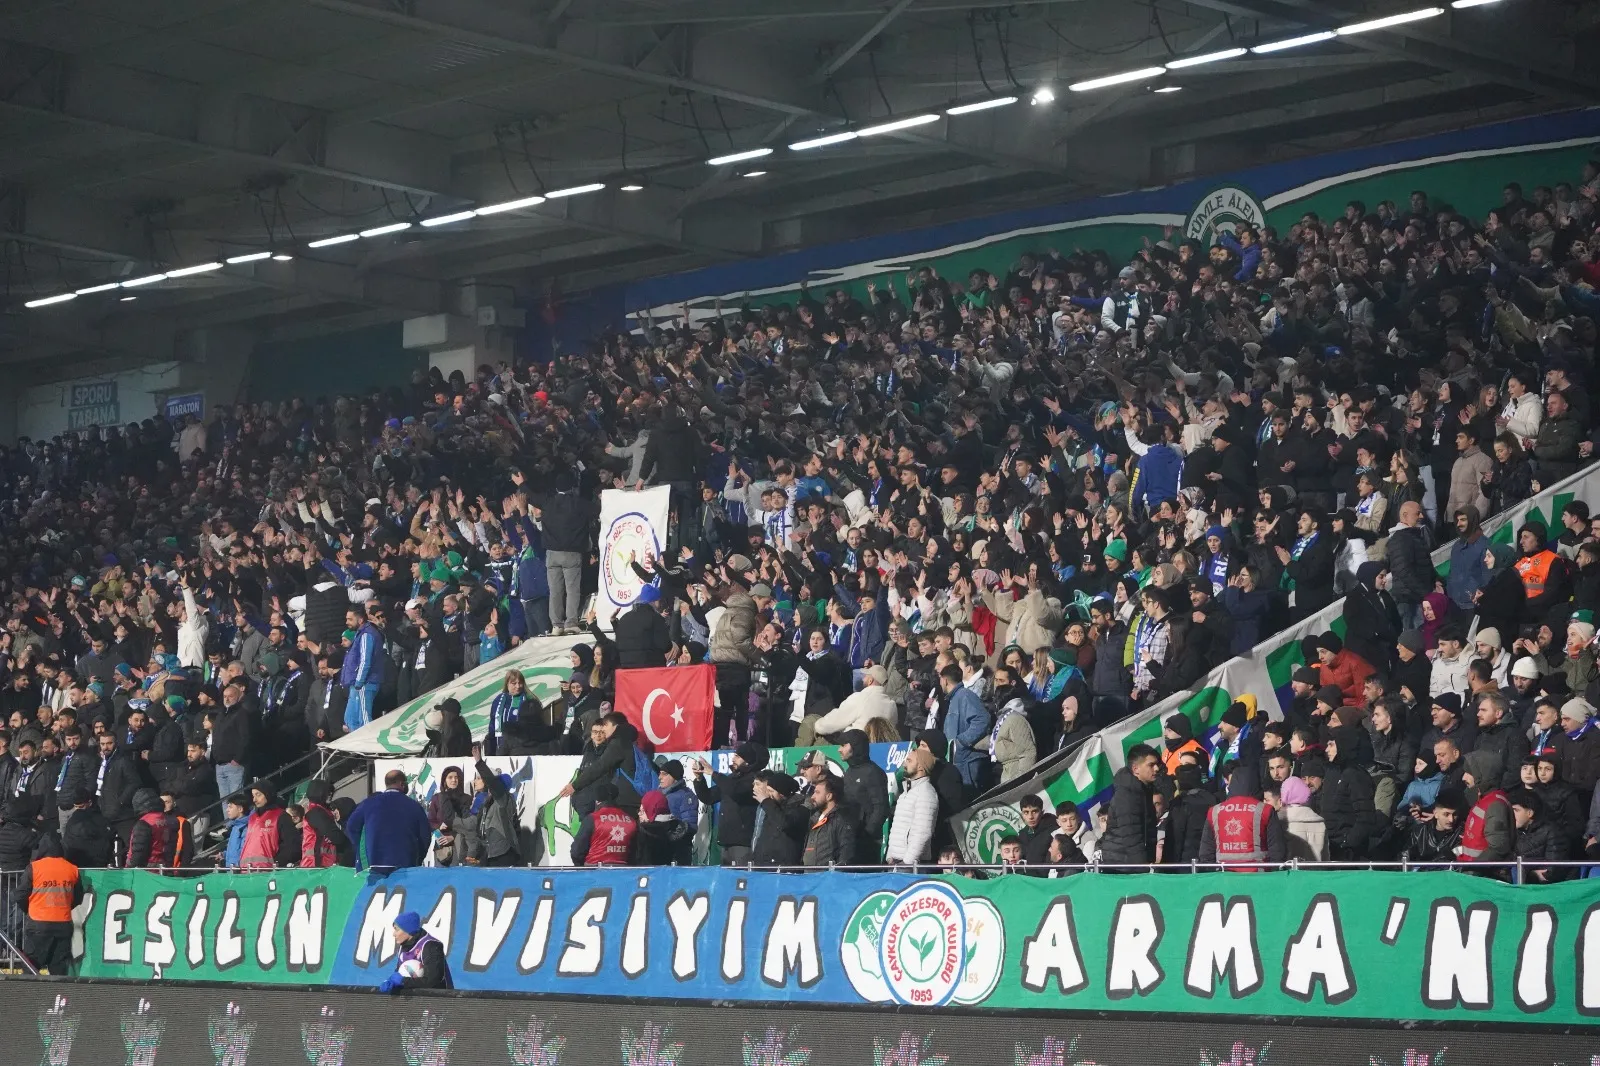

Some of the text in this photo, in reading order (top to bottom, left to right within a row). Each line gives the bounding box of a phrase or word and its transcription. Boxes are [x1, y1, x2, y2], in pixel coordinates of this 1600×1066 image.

[74, 384, 112, 405] SPORU
[71, 406, 117, 429] TABANA
[169, 401, 200, 417] MARATON
[617, 589, 632, 600] 1953
[354, 876, 824, 988] MAVİSİYİM
[887, 923, 904, 982] ÇAYKUR
[899, 896, 952, 922] RİZESPOR
[910, 988, 933, 1002] 1953
